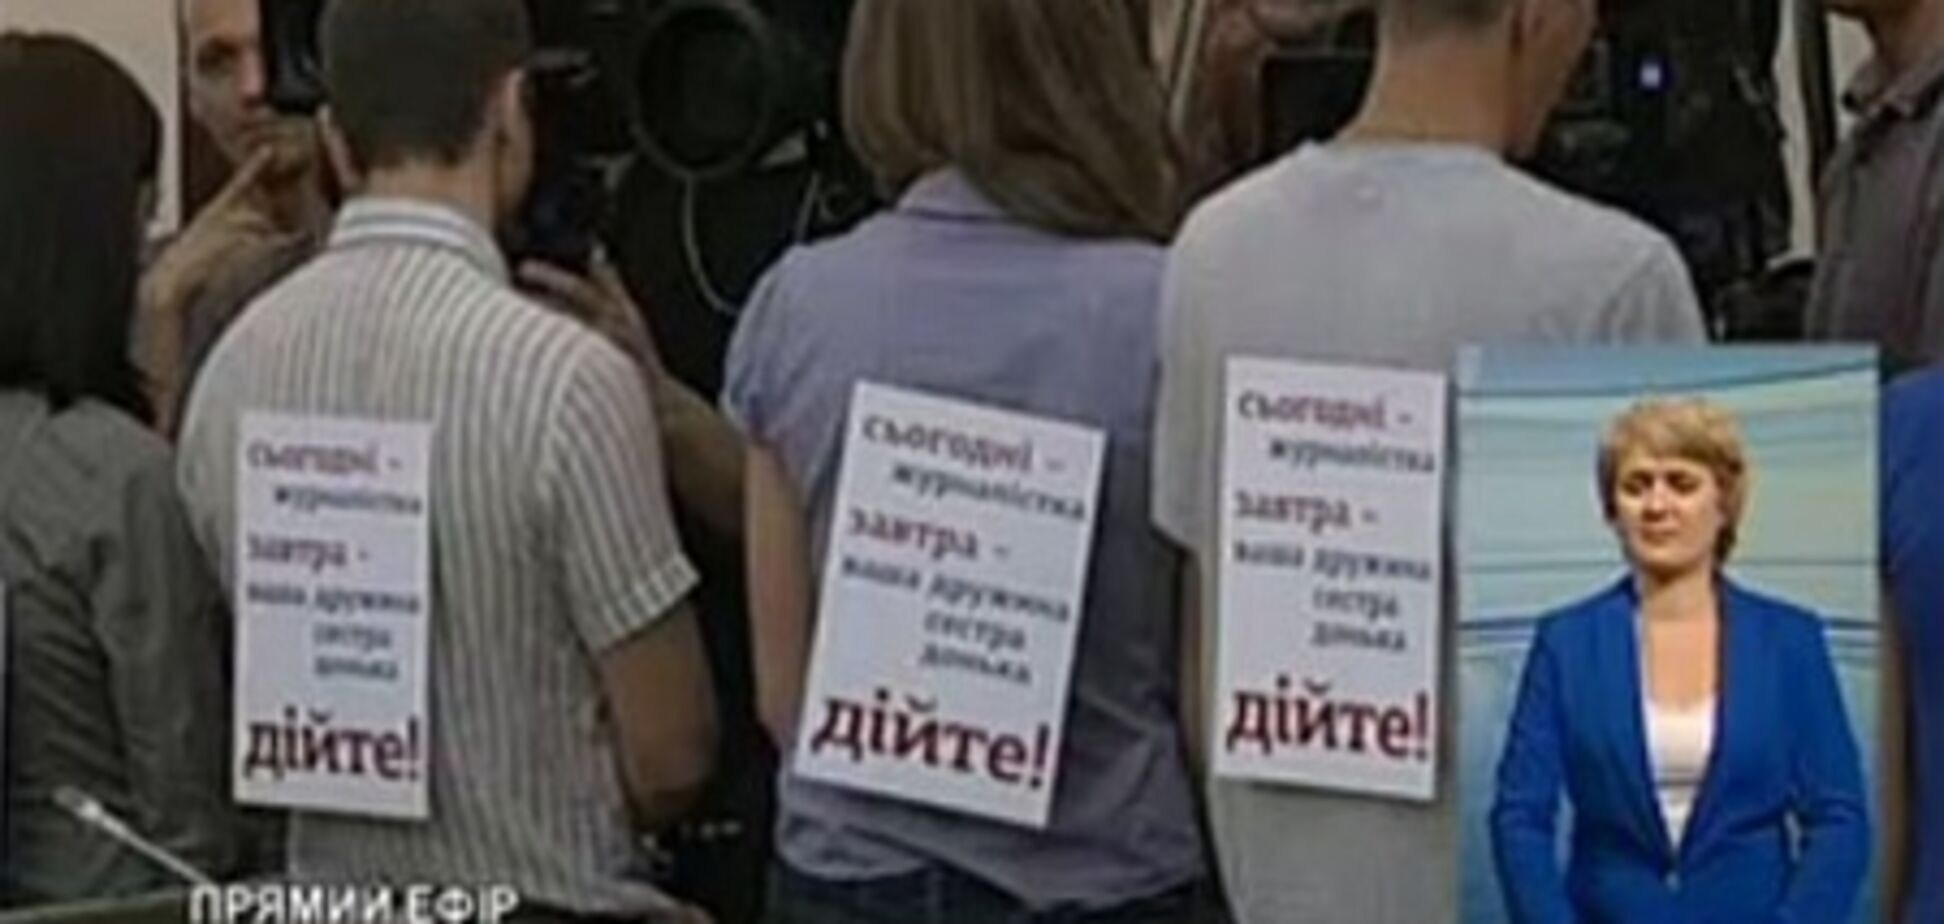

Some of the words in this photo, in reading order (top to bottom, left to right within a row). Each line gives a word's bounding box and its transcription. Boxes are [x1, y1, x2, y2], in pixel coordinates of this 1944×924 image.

[862, 414, 1034, 472] сьогодні
[892, 461, 1085, 520] журналістка
[1235, 489, 1351, 534] завтра
[849, 507, 977, 561] завтра
[842, 555, 920, 590] ваша
[928, 574, 1070, 622] дружина
[925, 611, 1026, 651] сестра
[921, 642, 1031, 684] донька
[242, 704, 420, 782] дійте!
[810, 686, 1052, 790] дійте!
[1225, 673, 1430, 762] дійте!
